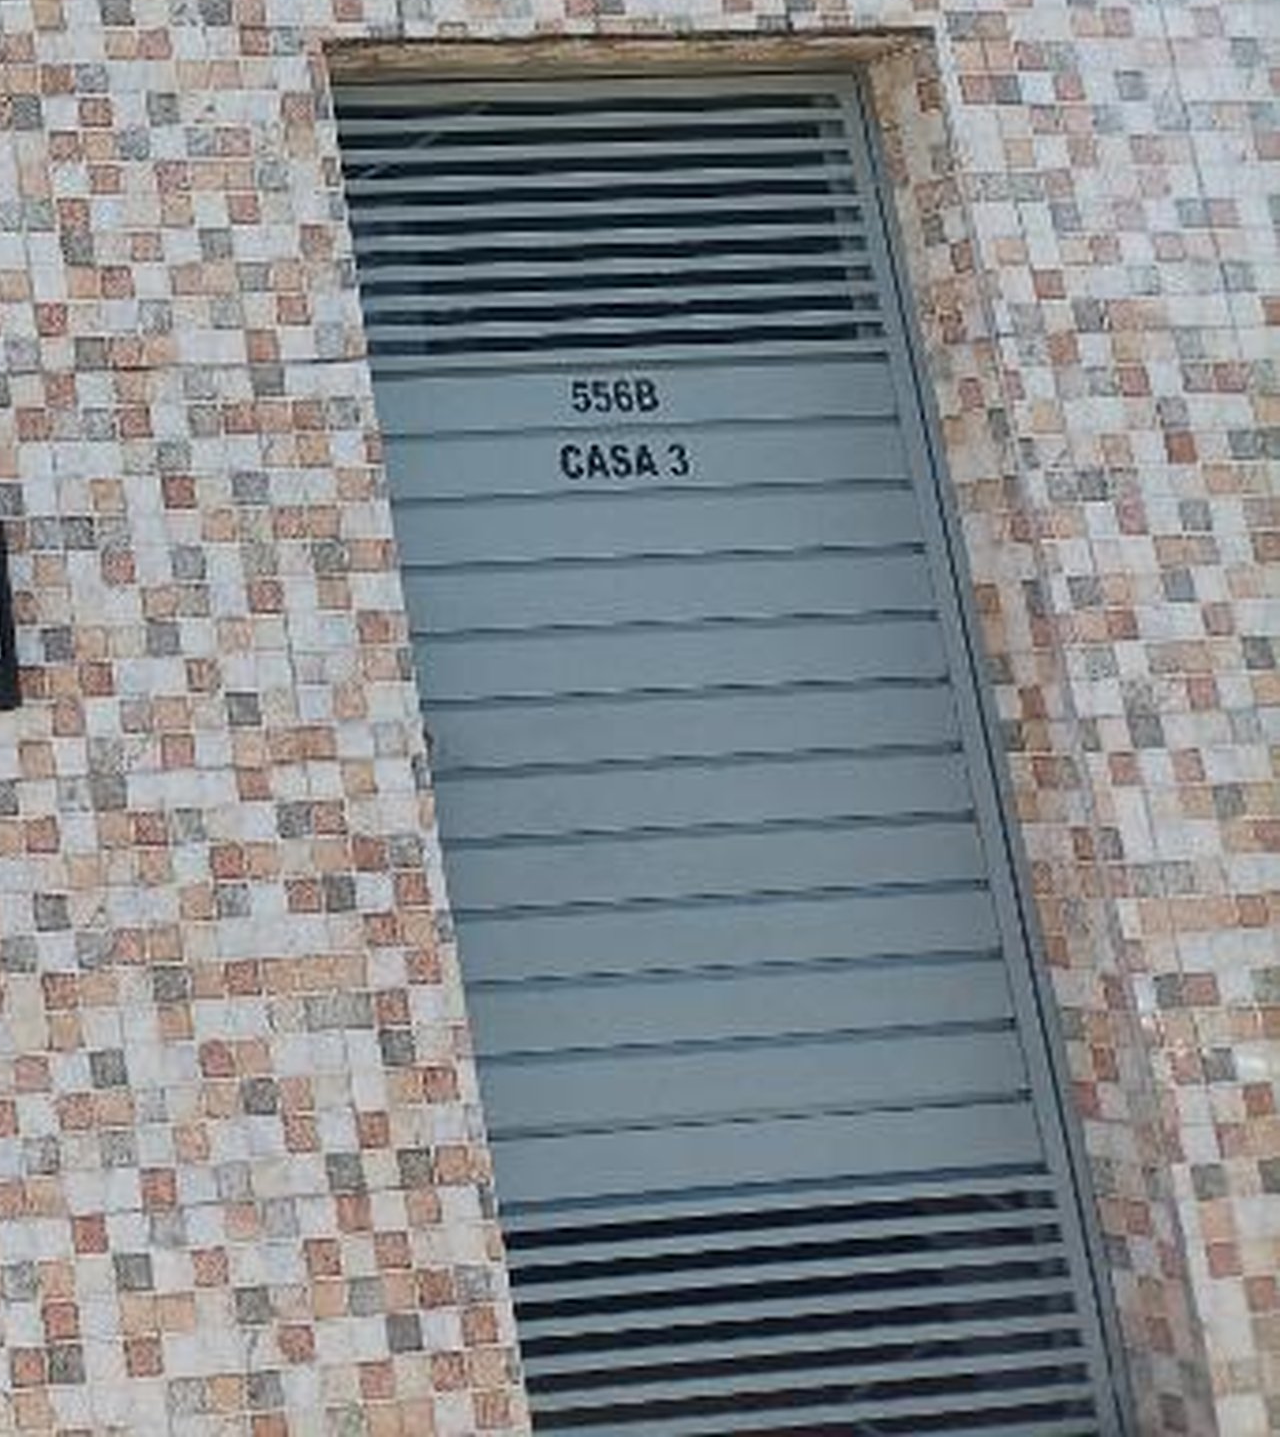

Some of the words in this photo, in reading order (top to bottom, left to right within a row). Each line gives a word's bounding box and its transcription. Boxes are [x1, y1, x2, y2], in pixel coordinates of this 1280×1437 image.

[571, 378, 660, 413] 556B
[560, 444, 659, 479] CASA
[668, 444, 690, 476] 3
